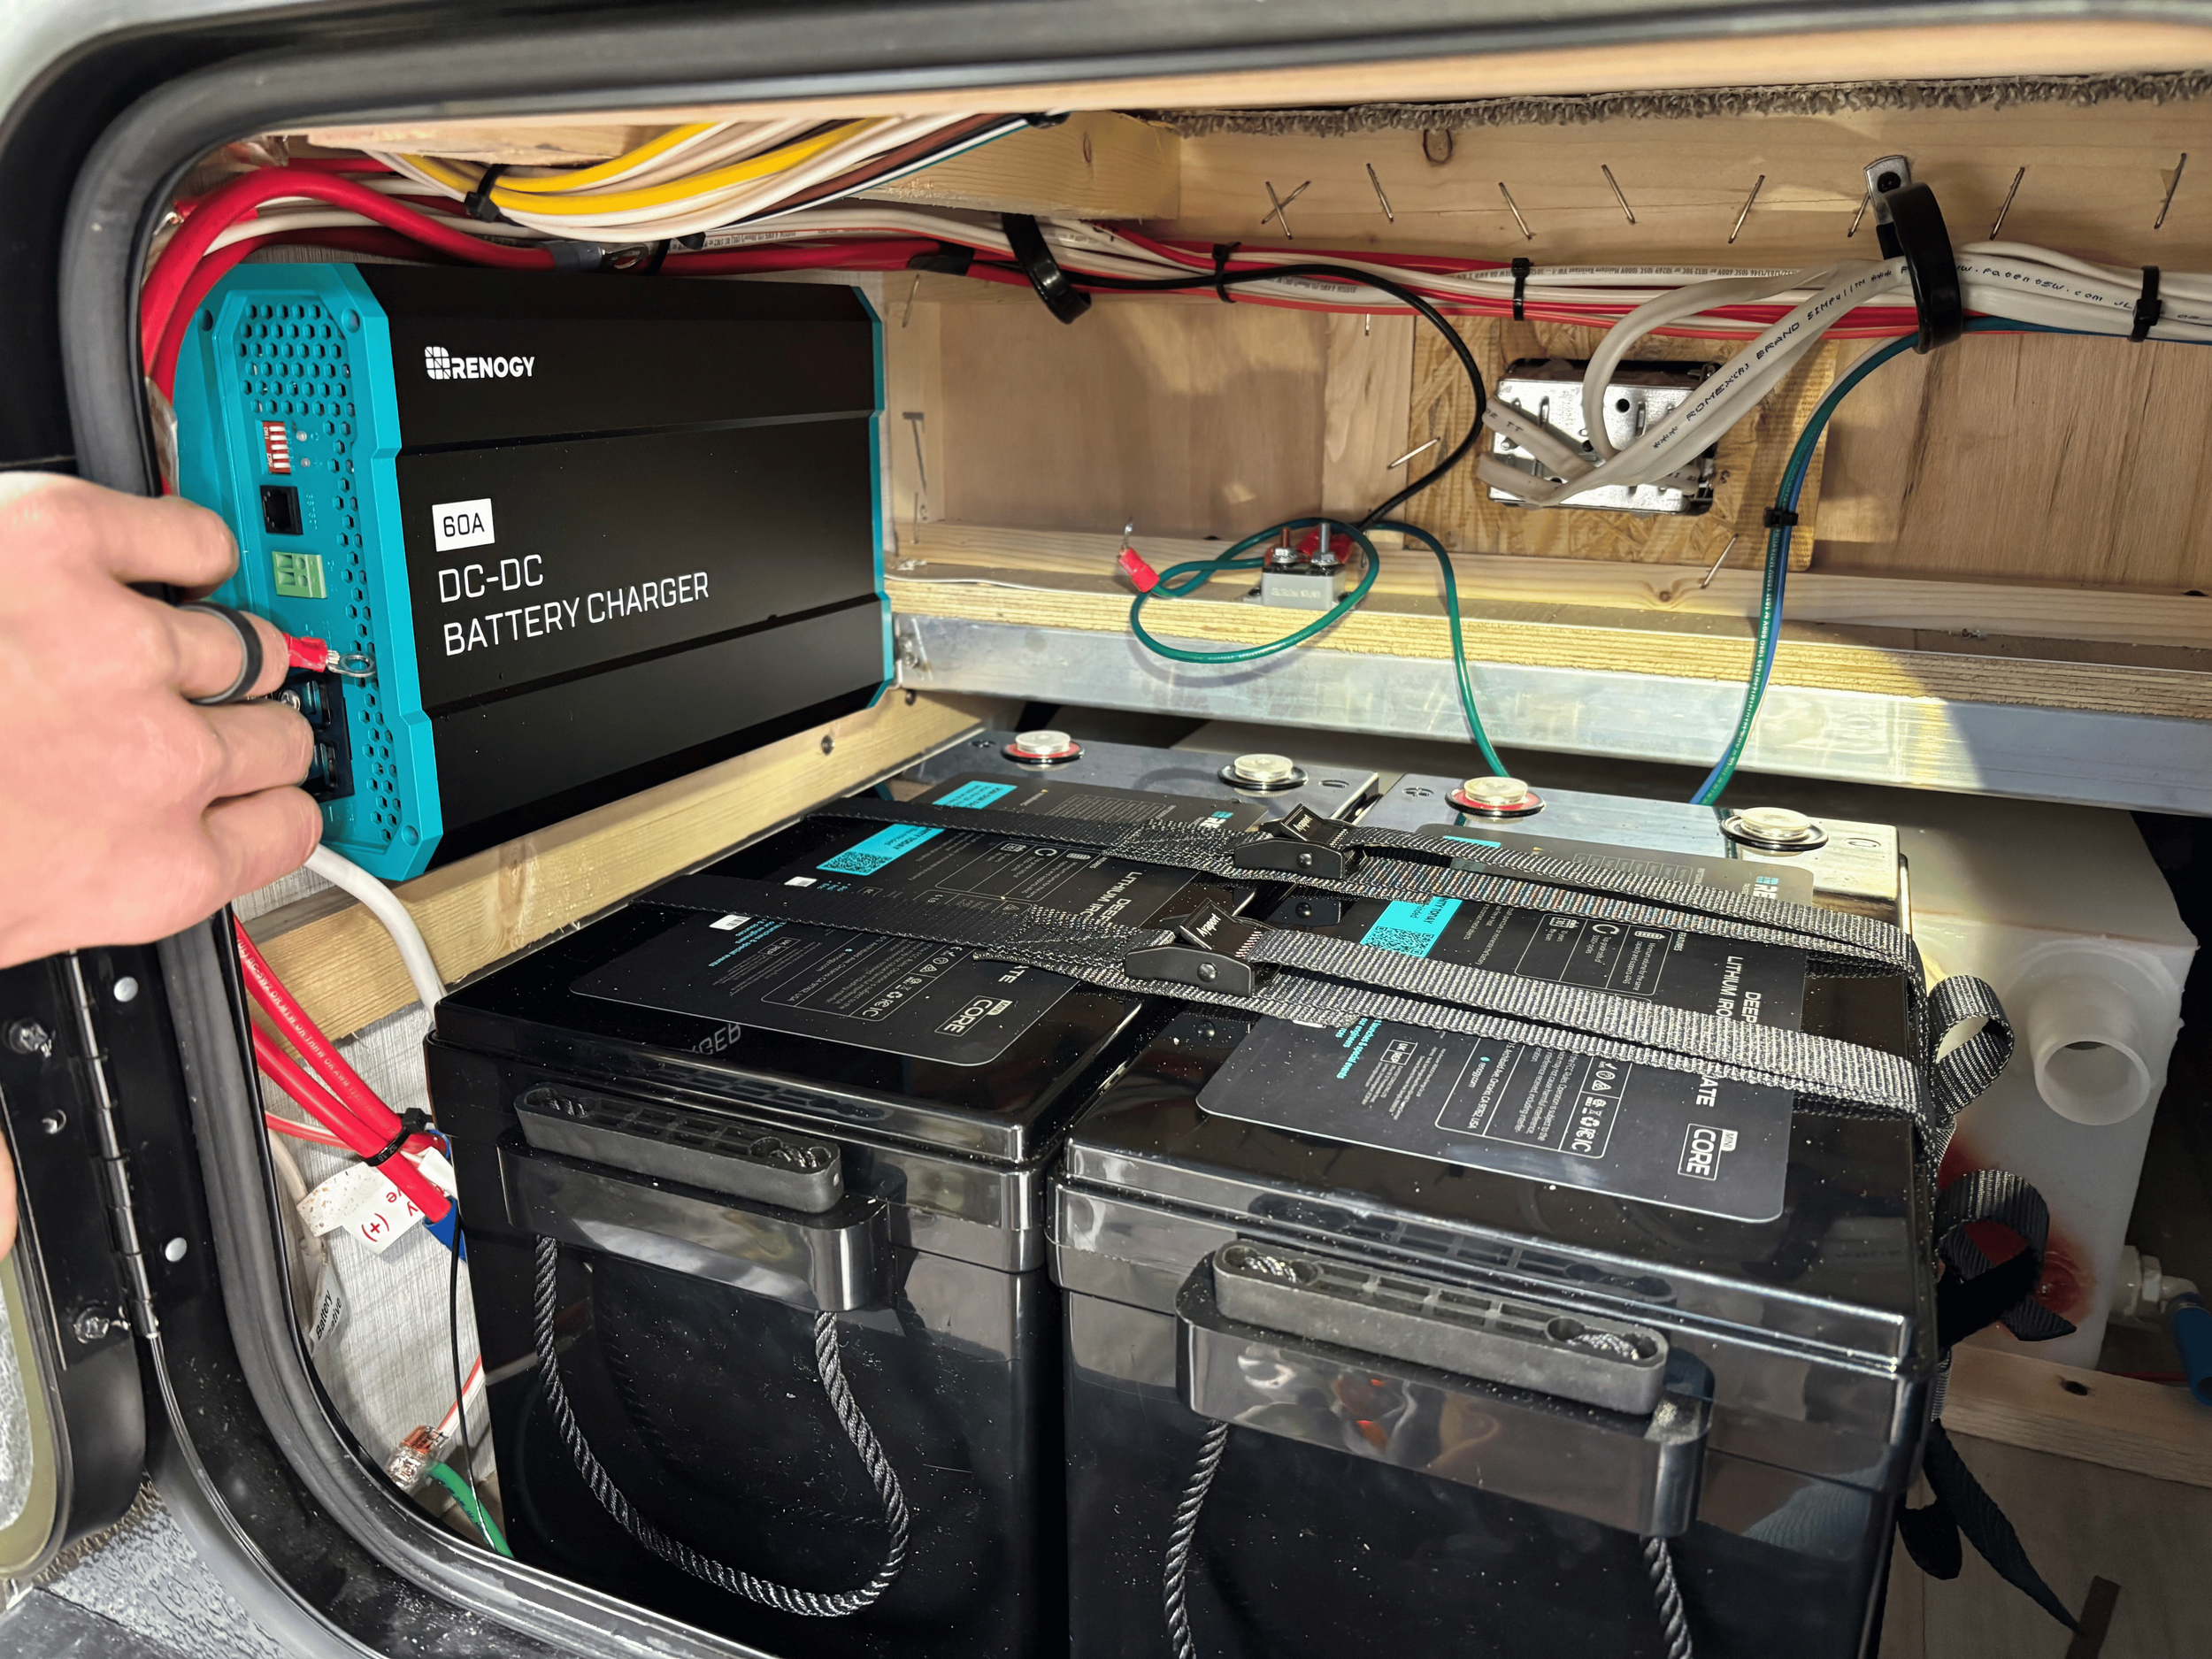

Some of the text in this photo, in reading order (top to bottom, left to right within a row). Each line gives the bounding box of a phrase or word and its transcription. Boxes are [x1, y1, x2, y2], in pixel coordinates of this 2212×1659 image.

[451, 356, 535, 380] RENOGY
[442, 512, 485, 537] 60A
[438, 554, 543, 603] DC-DC
[443, 572, 709, 656] BATTERY CHARGER
[1097, 872, 1142, 902] LITHIUM
[1421, 908, 1441, 925] TODAY
[1719, 955, 1743, 998] LITHIUM
[943, 999, 994, 1033] CORE
[1340, 1017, 1369, 1048] our engineers
[1359, 1022, 1381, 1042] launches
[1345, 1045, 1366, 1063] special
[1388, 1042, 1409, 1063] UK REP
[1495, 1048, 1513, 1069] Archibald
[1334, 1061, 1354, 1079] events
[1465, 1061, 1486, 1088] renogy.com
[1490, 1068, 1503, 1079] Ave,
[1479, 1094, 1491, 1103] CA
[1481, 1077, 1499, 1096] Ontario,
[1466, 1117, 1480, 1129] USA
[1686, 1128, 1717, 1176] CORE
[316, 1289, 332, 1340] Battery
